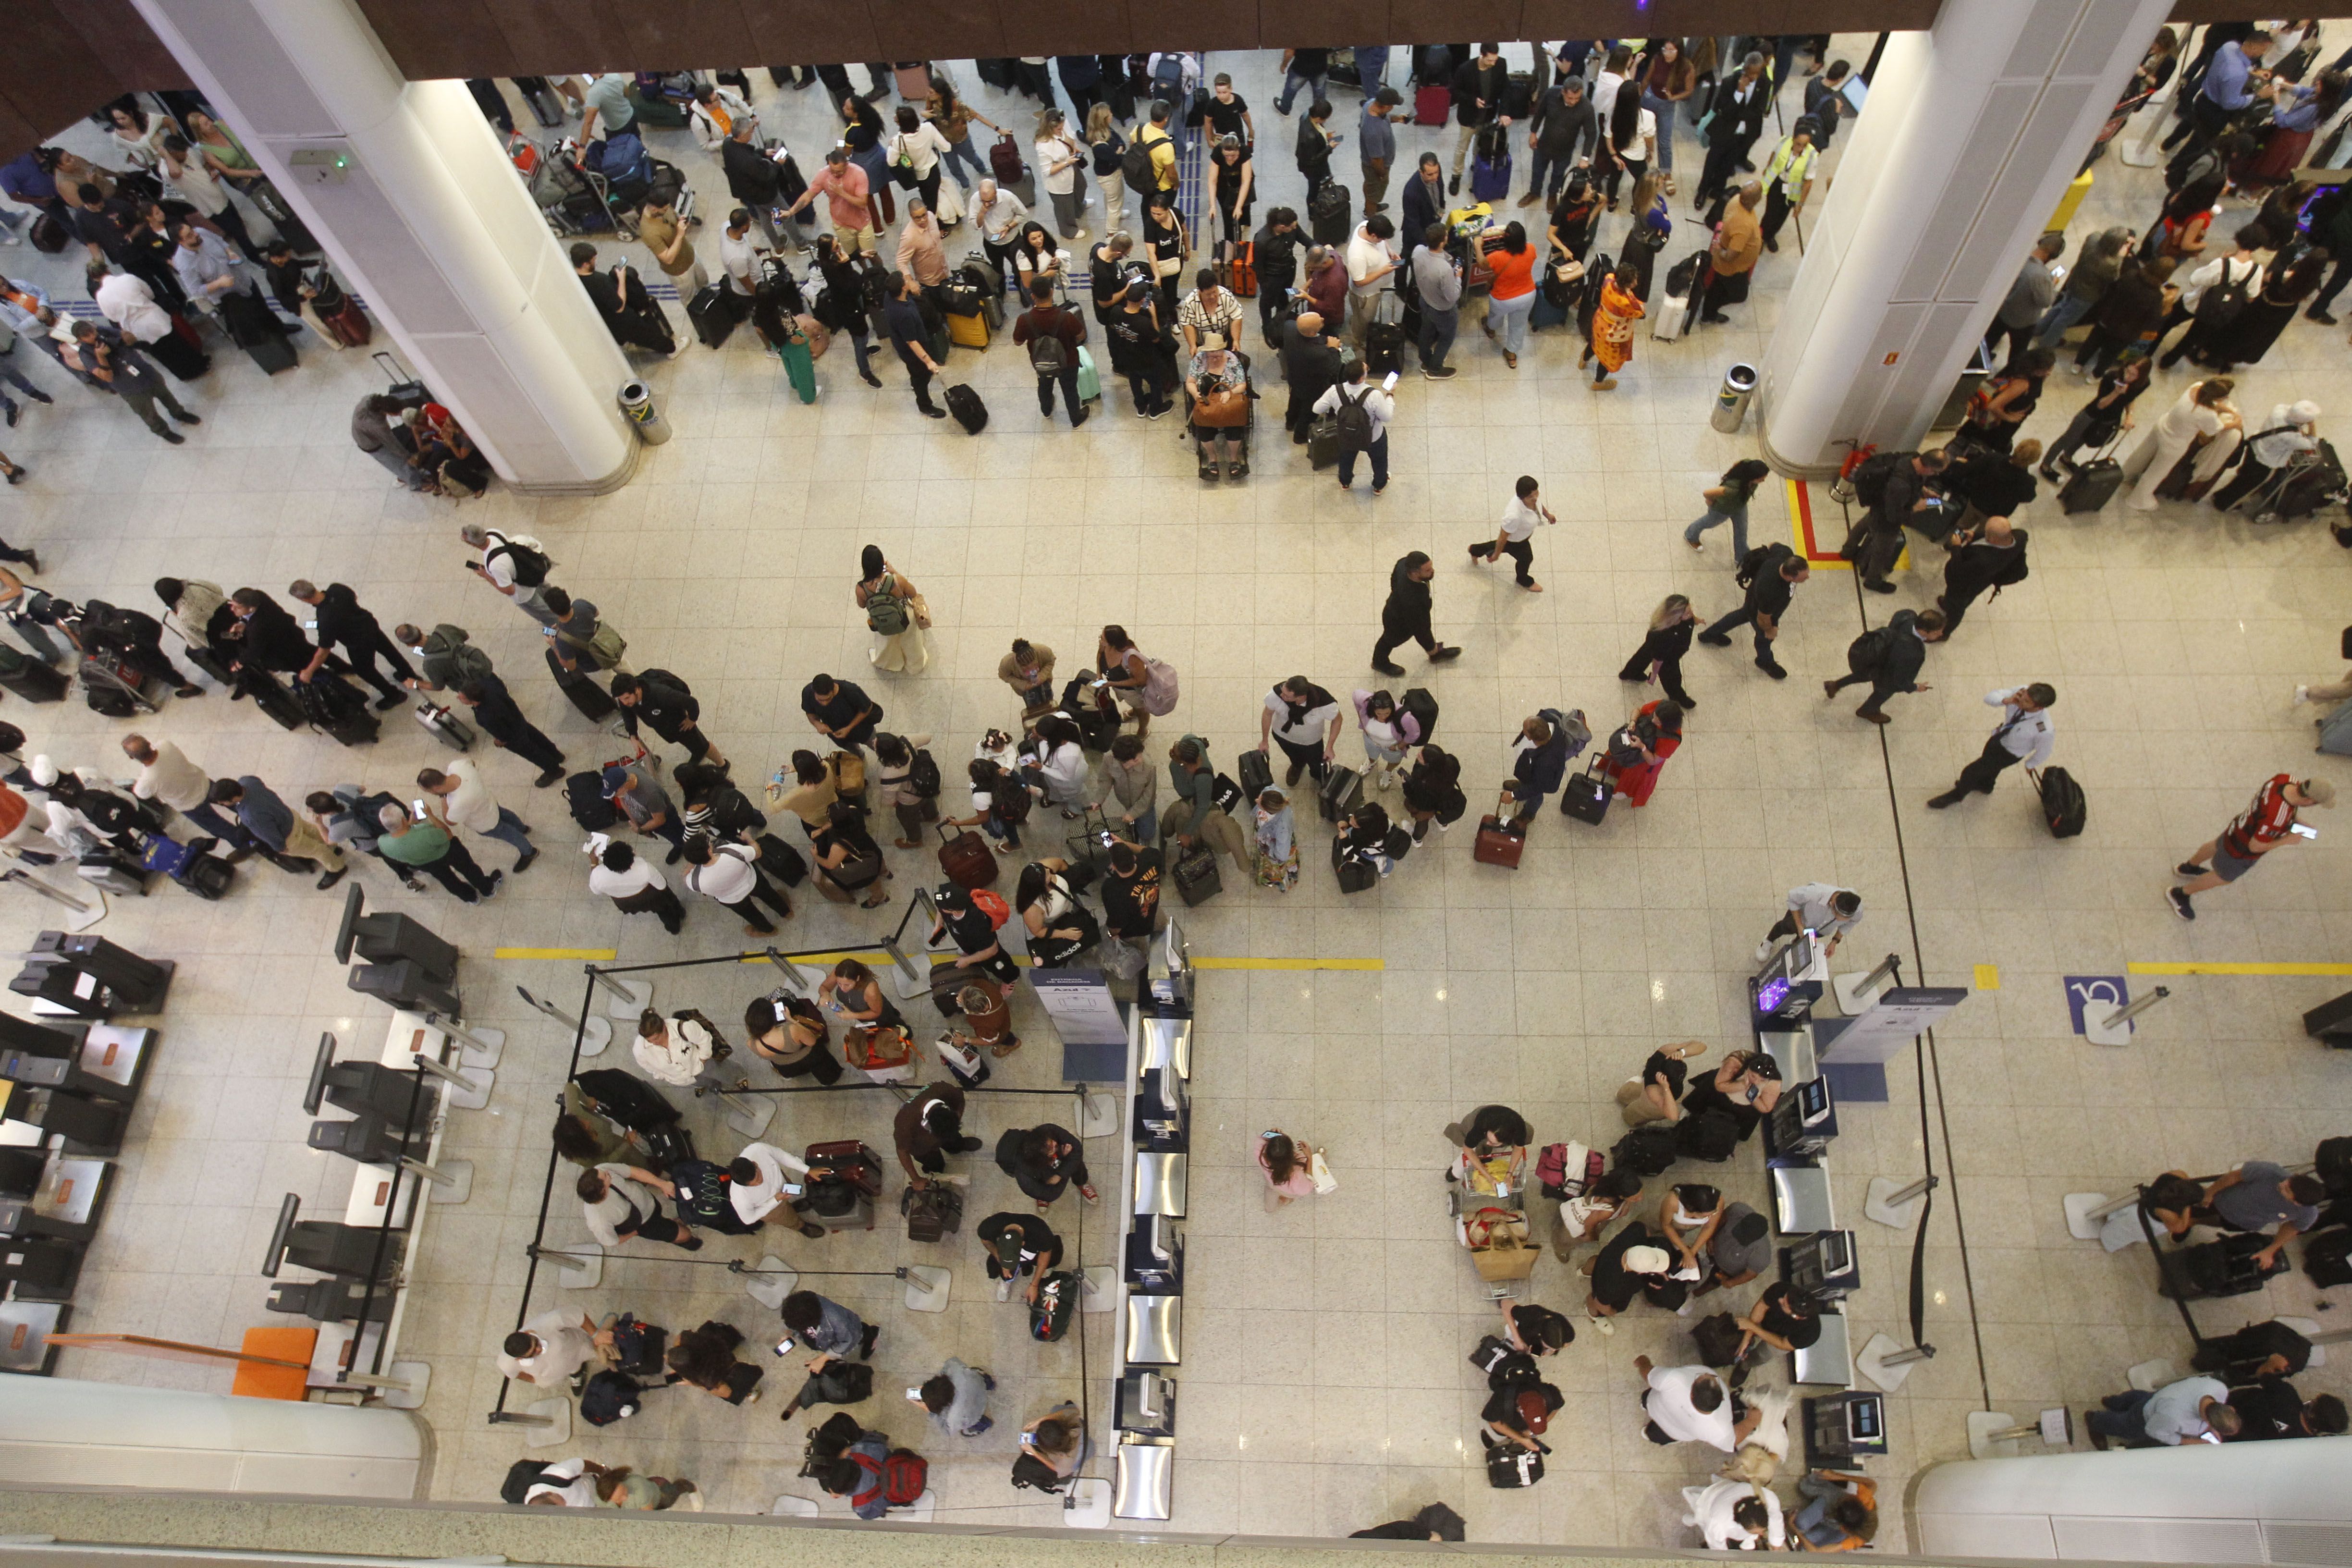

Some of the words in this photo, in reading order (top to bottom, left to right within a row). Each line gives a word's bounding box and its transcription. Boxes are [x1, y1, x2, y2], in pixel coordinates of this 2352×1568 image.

[1055, 942, 1081, 960] adidas
[1156, 992, 1175, 1004] Azul
[1150, 1128, 1171, 1139] Azul
